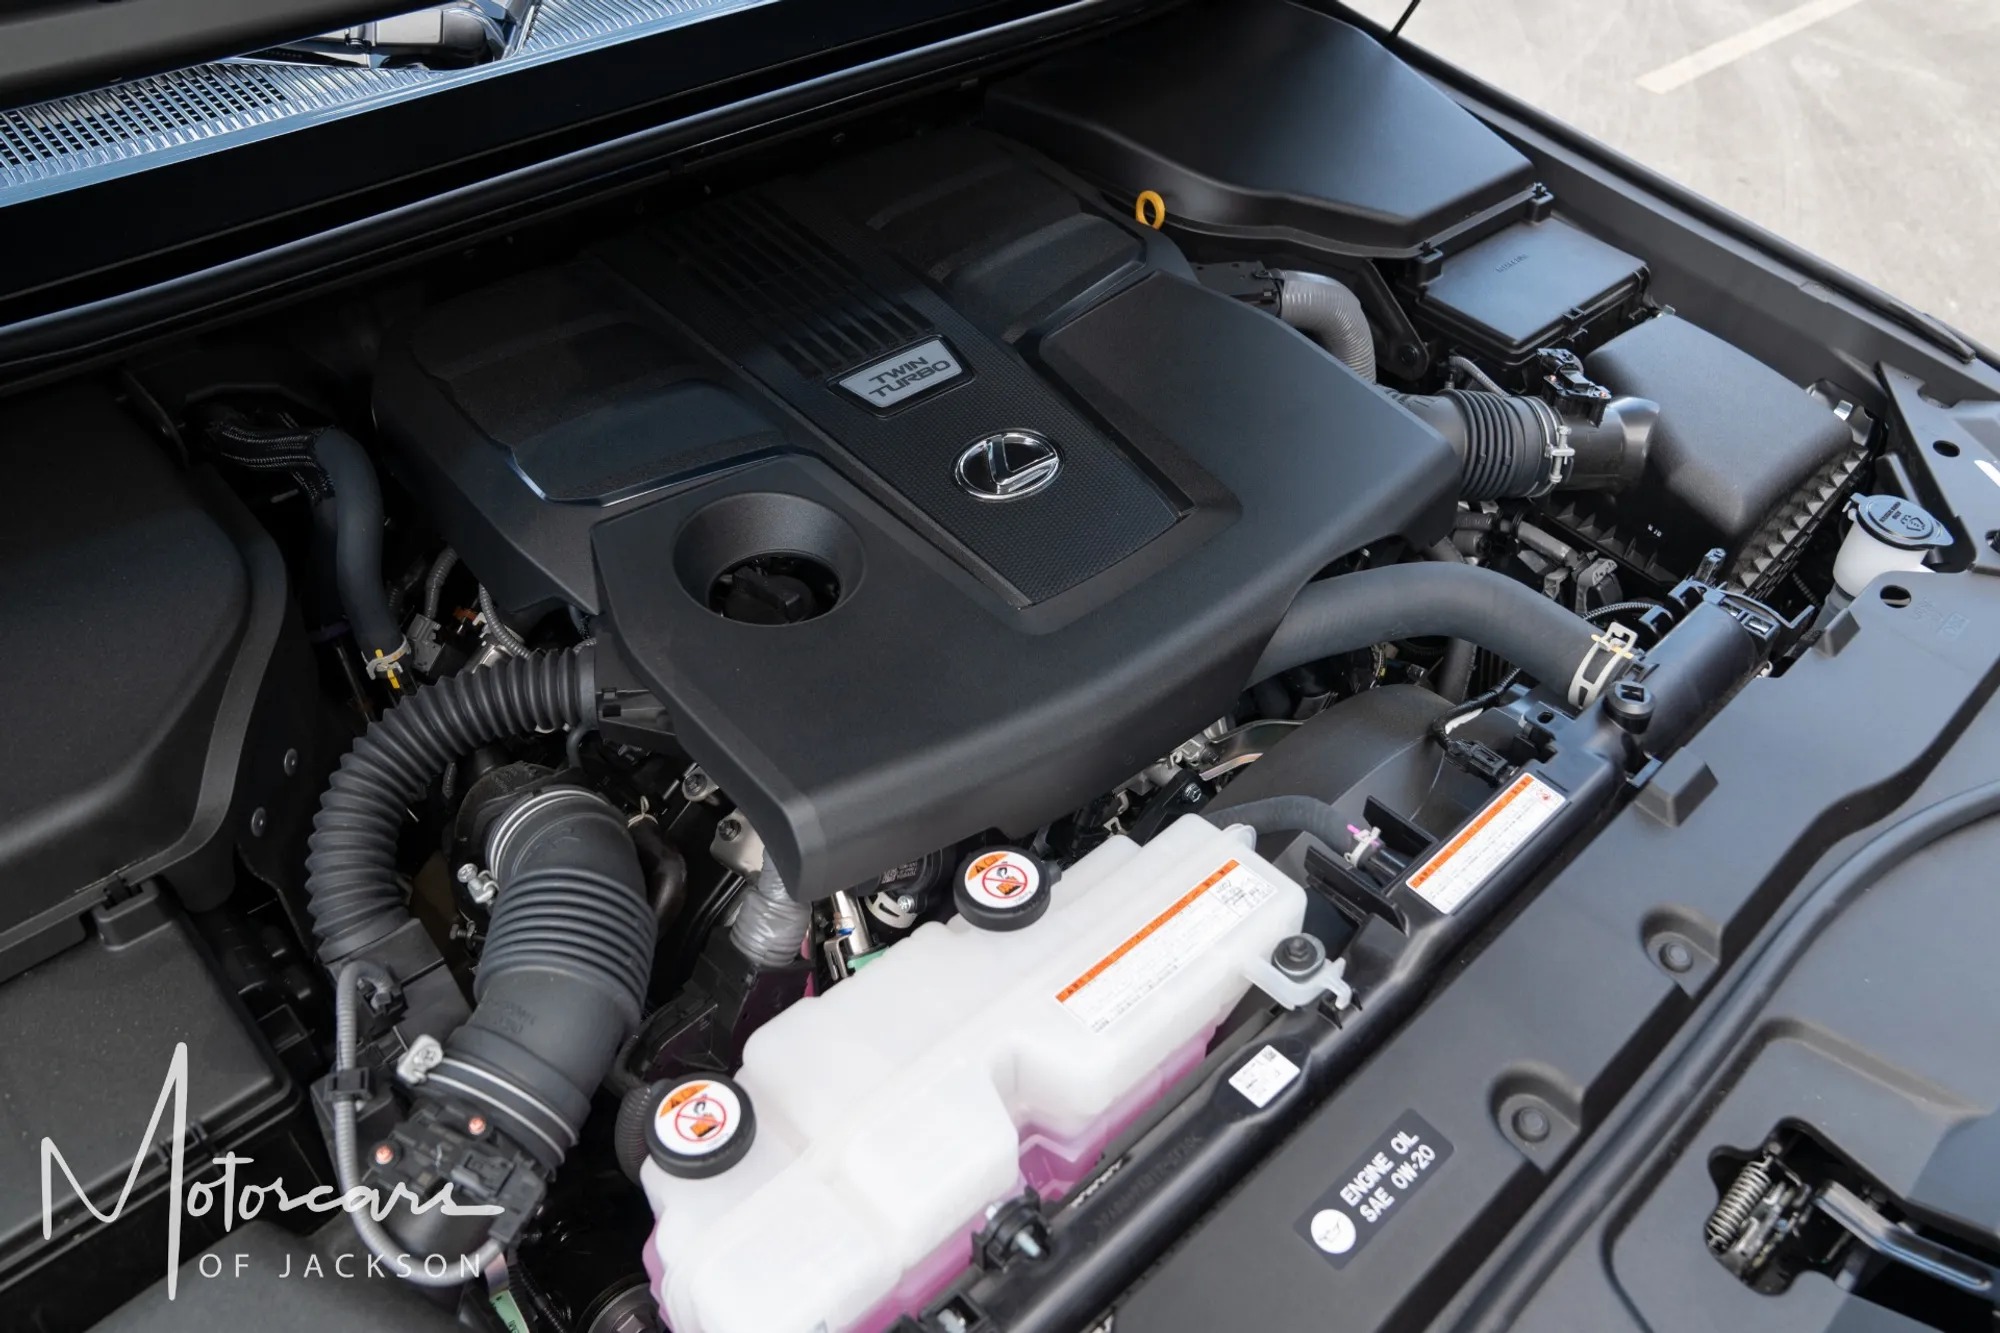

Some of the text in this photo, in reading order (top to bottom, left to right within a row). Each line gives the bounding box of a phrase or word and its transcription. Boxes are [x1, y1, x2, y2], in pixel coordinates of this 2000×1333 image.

[868, 356, 930, 384] TWIN
[868, 359, 951, 398] TURBO
[1340, 1130, 1420, 1207] ENGINE OIL
[1359, 1186, 1395, 1223] SAE
